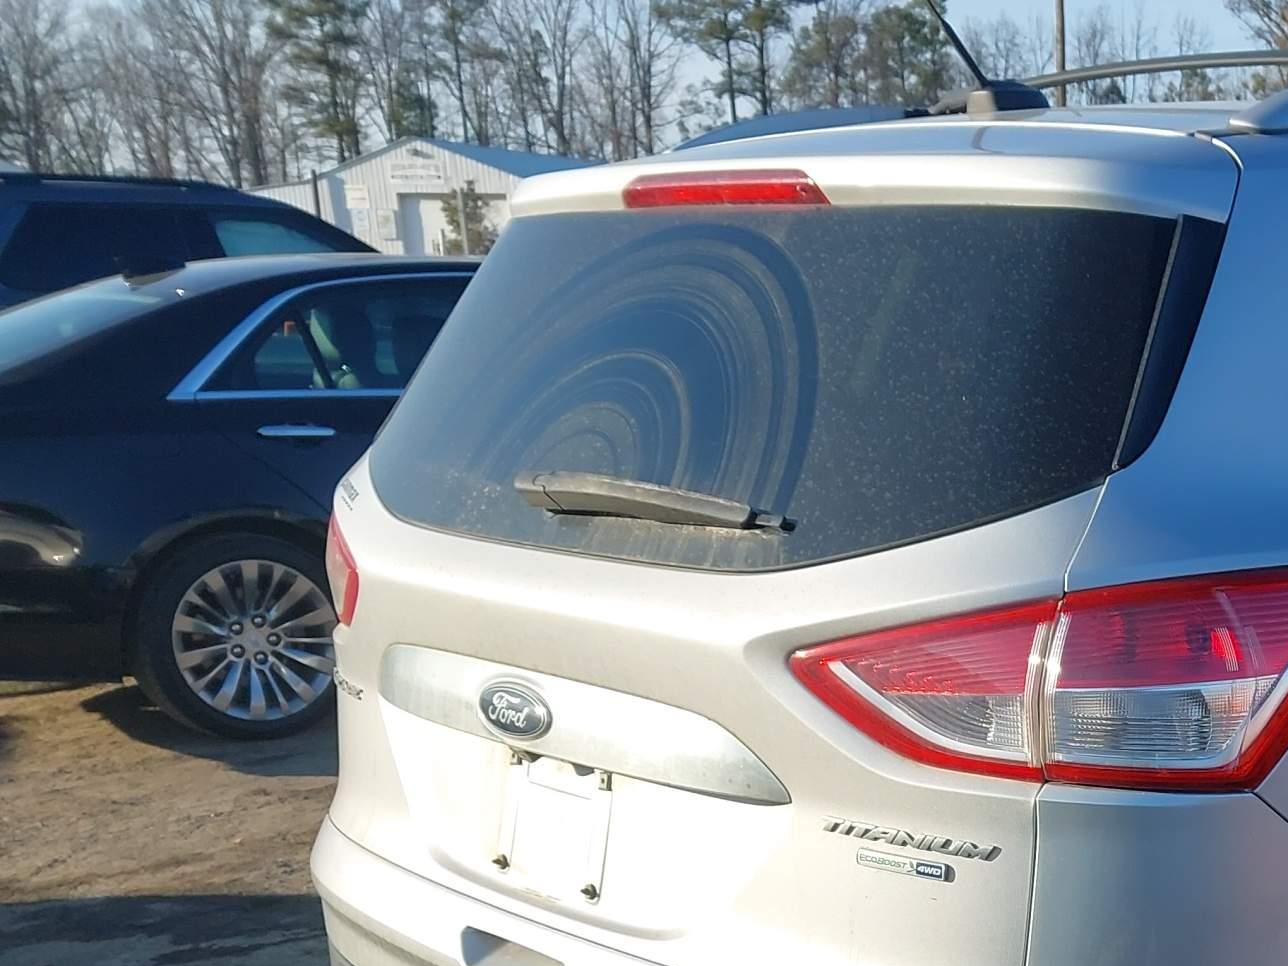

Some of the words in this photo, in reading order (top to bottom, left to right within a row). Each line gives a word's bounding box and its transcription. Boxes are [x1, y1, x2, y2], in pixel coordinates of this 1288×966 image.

[488, 691, 529, 728] Ford
[820, 815, 1002, 862] TITANIUM
[917, 865, 942, 876] 4WD
